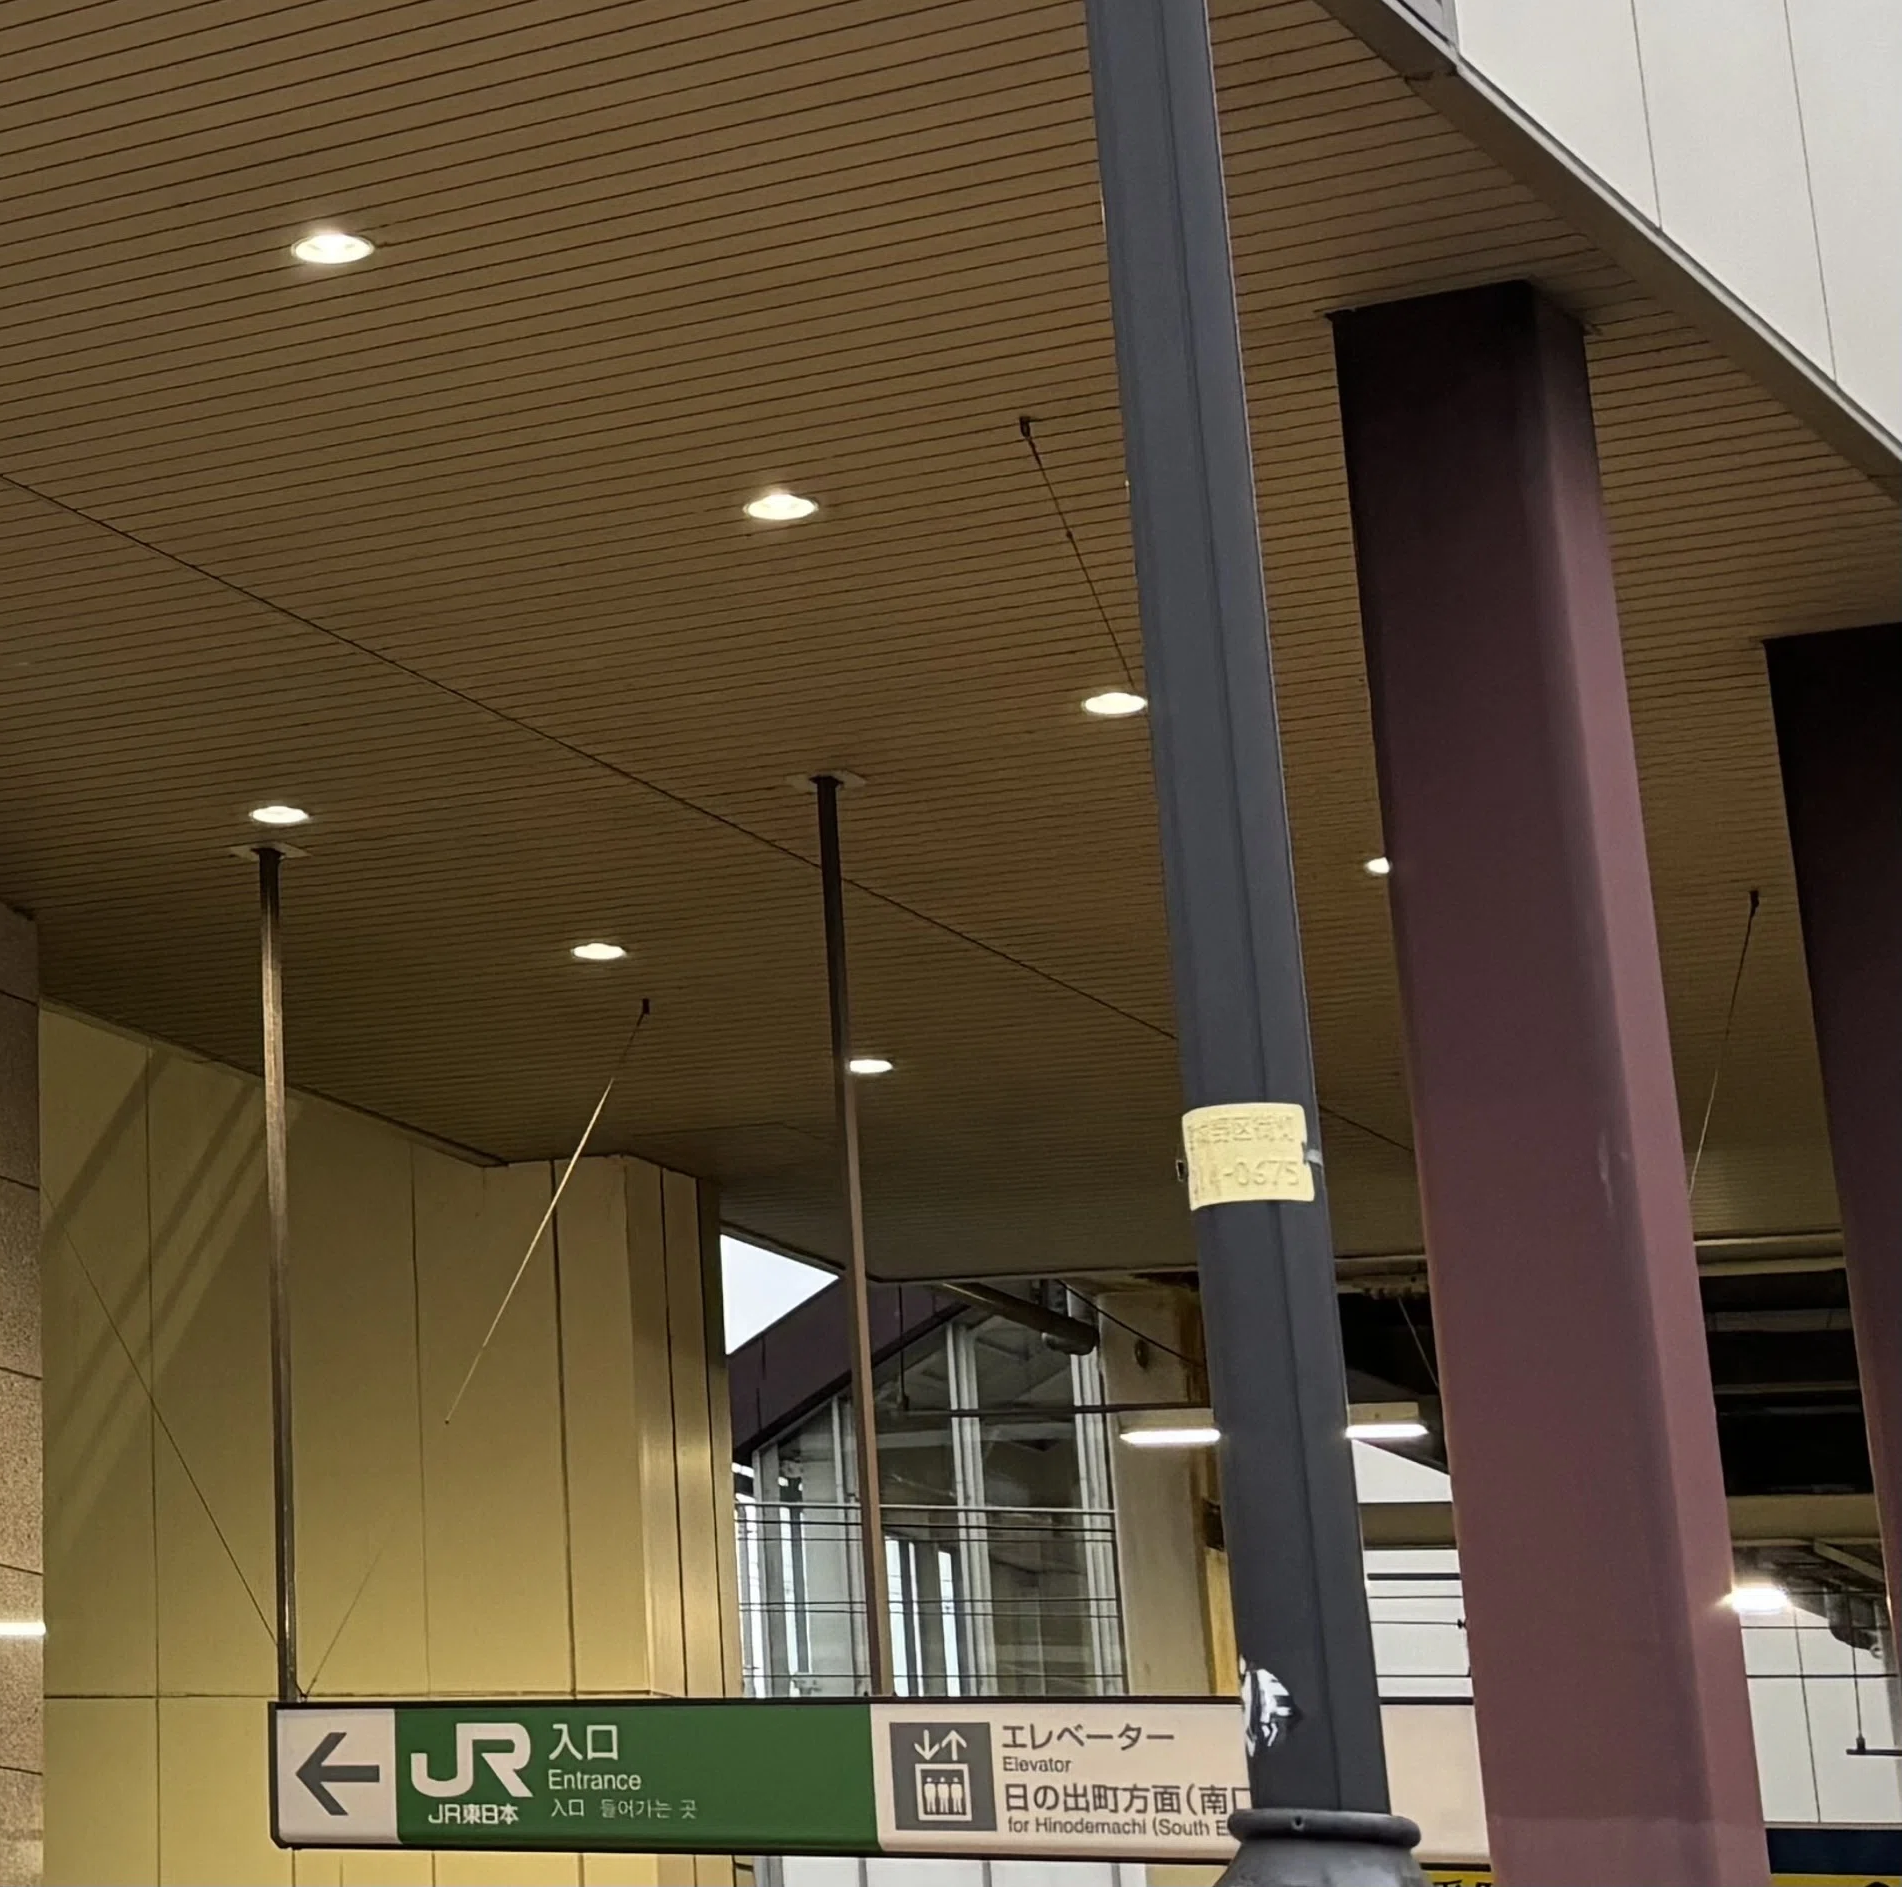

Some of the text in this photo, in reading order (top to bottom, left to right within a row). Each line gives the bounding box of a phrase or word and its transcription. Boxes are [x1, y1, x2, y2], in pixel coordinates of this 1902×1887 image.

[548, 1723, 619, 1761] 入口
[1001, 1723, 1175, 1751] エレベーター
[410, 1722, 534, 1798] JR
[1002, 1756, 1072, 1773] Elevator
[548, 1769, 642, 1791] Entrance
[428, 1803, 520, 1825] JR東日本
[551, 1798, 585, 1818] 入口
[599, 1799, 698, 1820] 들어가는 곳
[1008, 1817, 1029, 1833] for
[1035, 1817, 1146, 1836] Hinodemachi
[1152, 1818, 1210, 1837] (South
